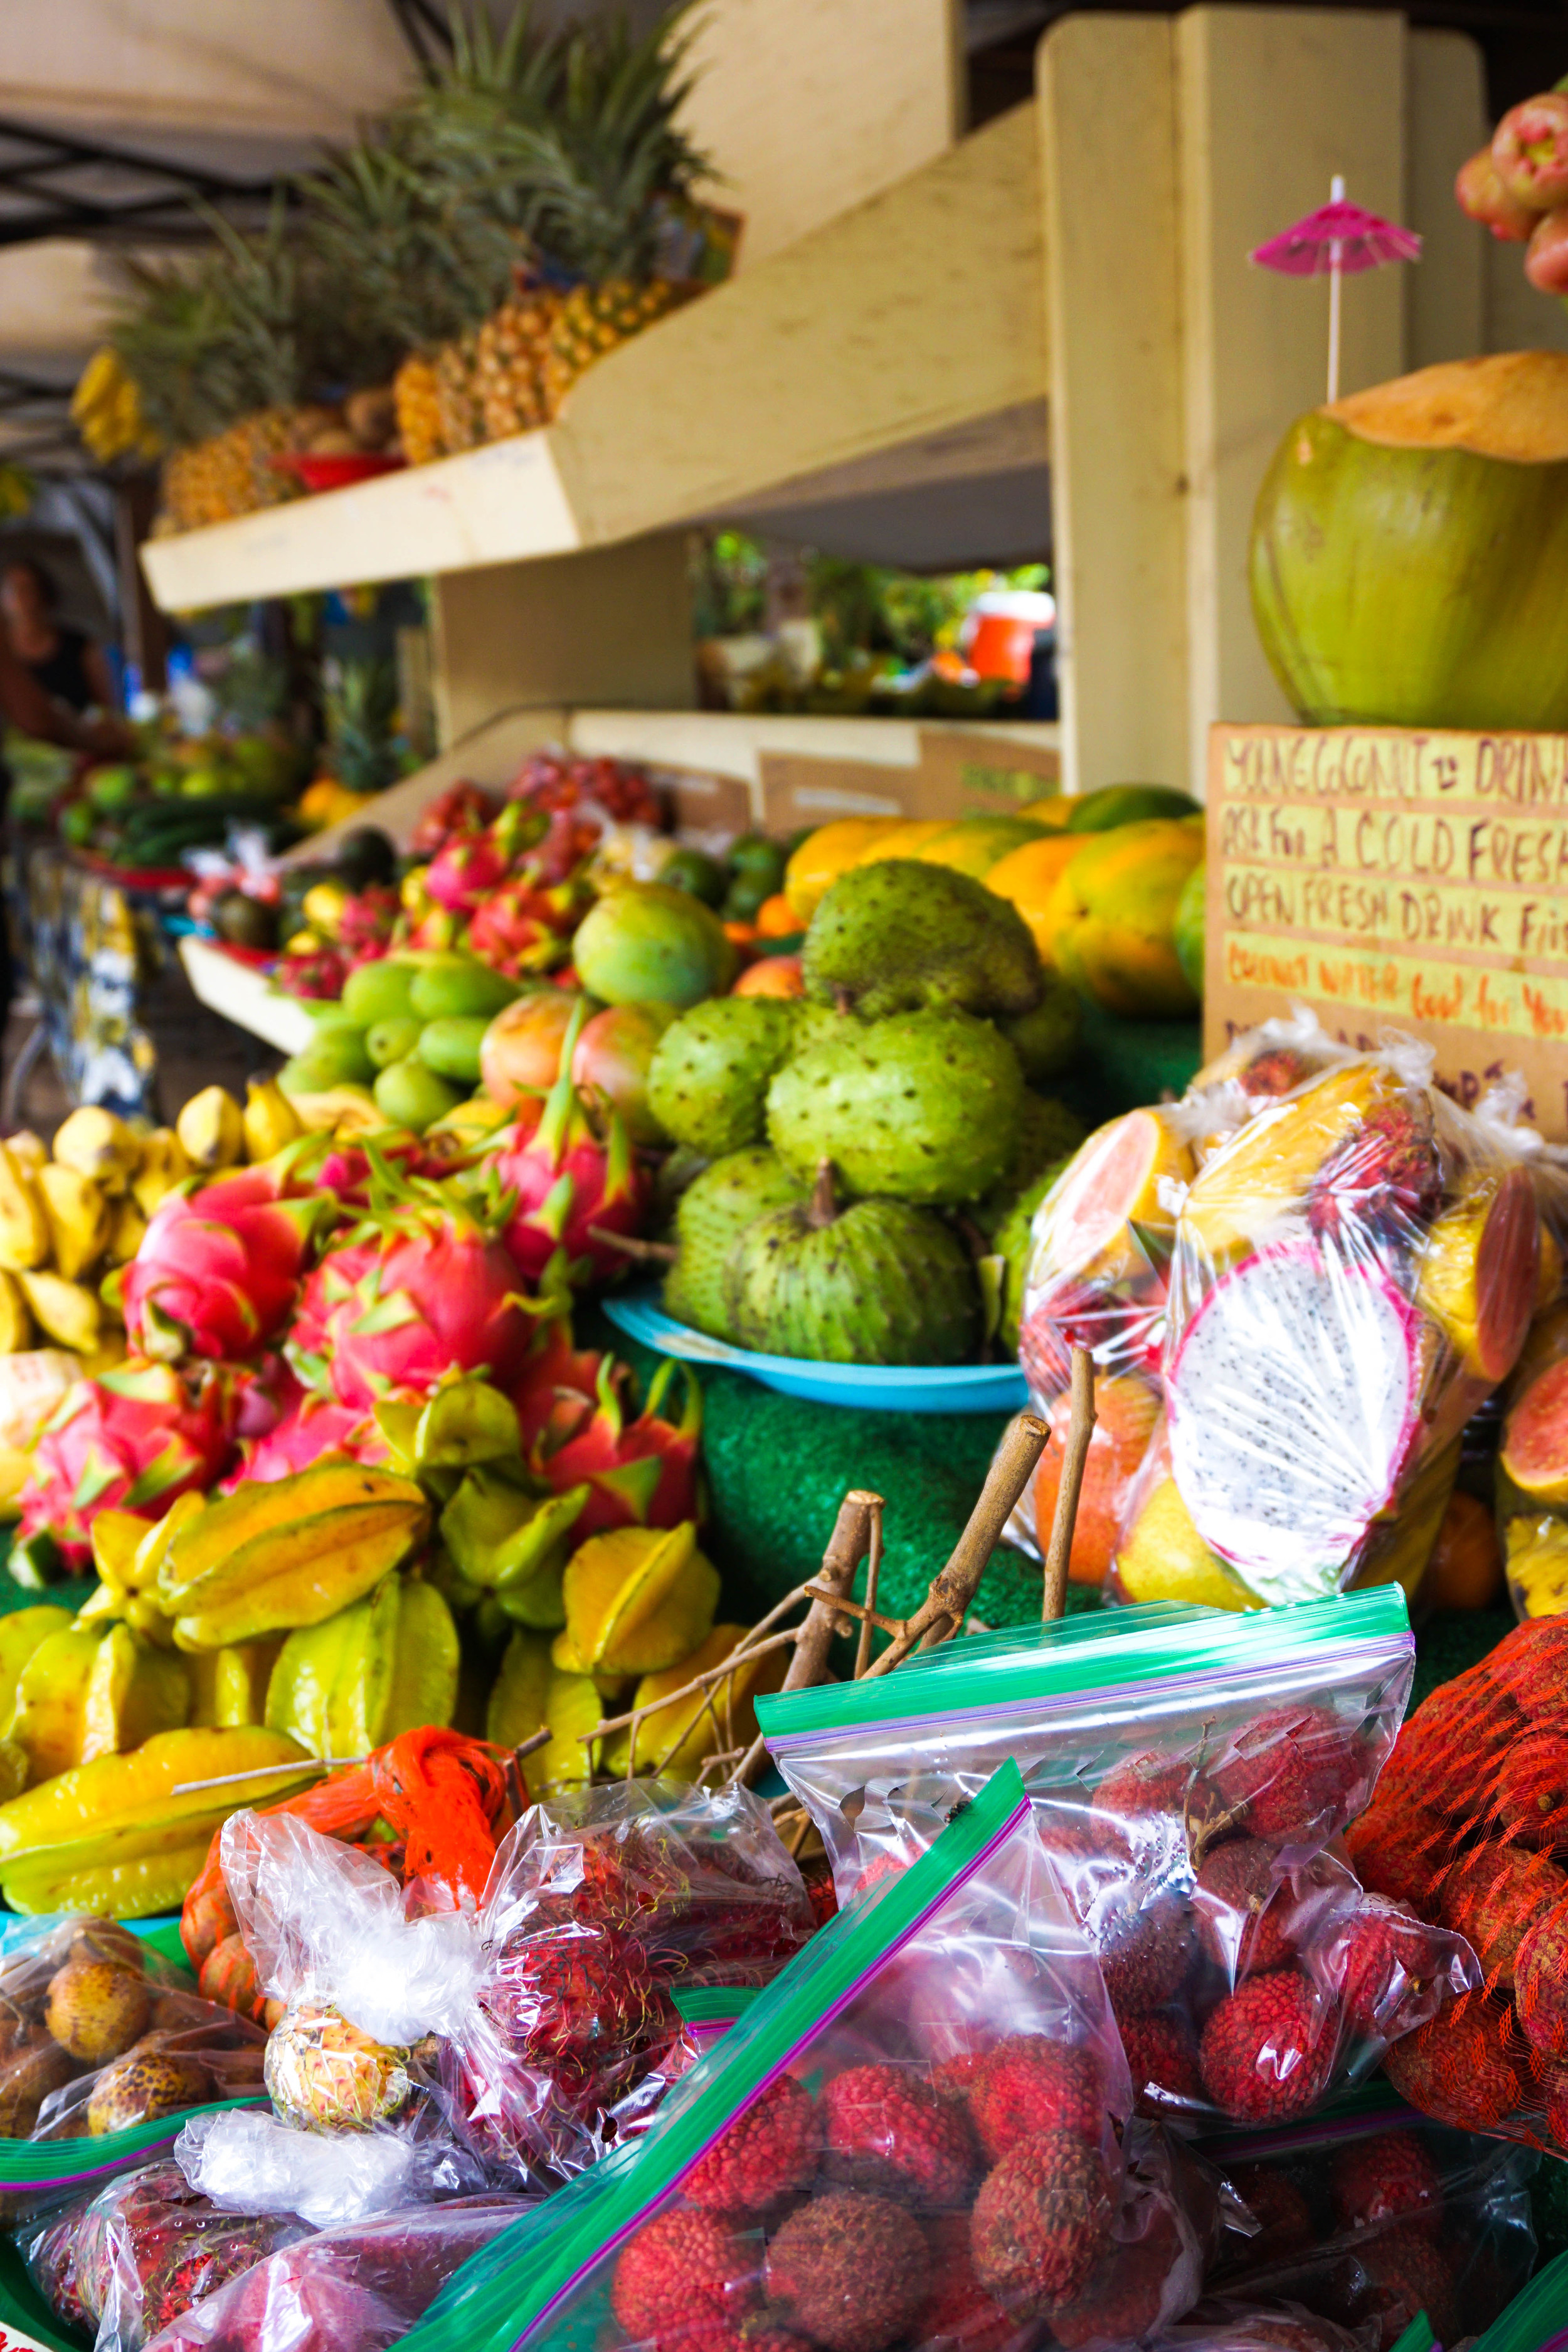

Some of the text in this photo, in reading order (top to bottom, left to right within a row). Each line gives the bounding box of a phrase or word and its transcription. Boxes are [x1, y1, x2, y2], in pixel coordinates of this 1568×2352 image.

[1355, 808, 1455, 876] COLD
[1227, 872, 1295, 927] OPEN
[1303, 877, 1388, 933] FRESH
[1400, 889, 1501, 945] DRINK
